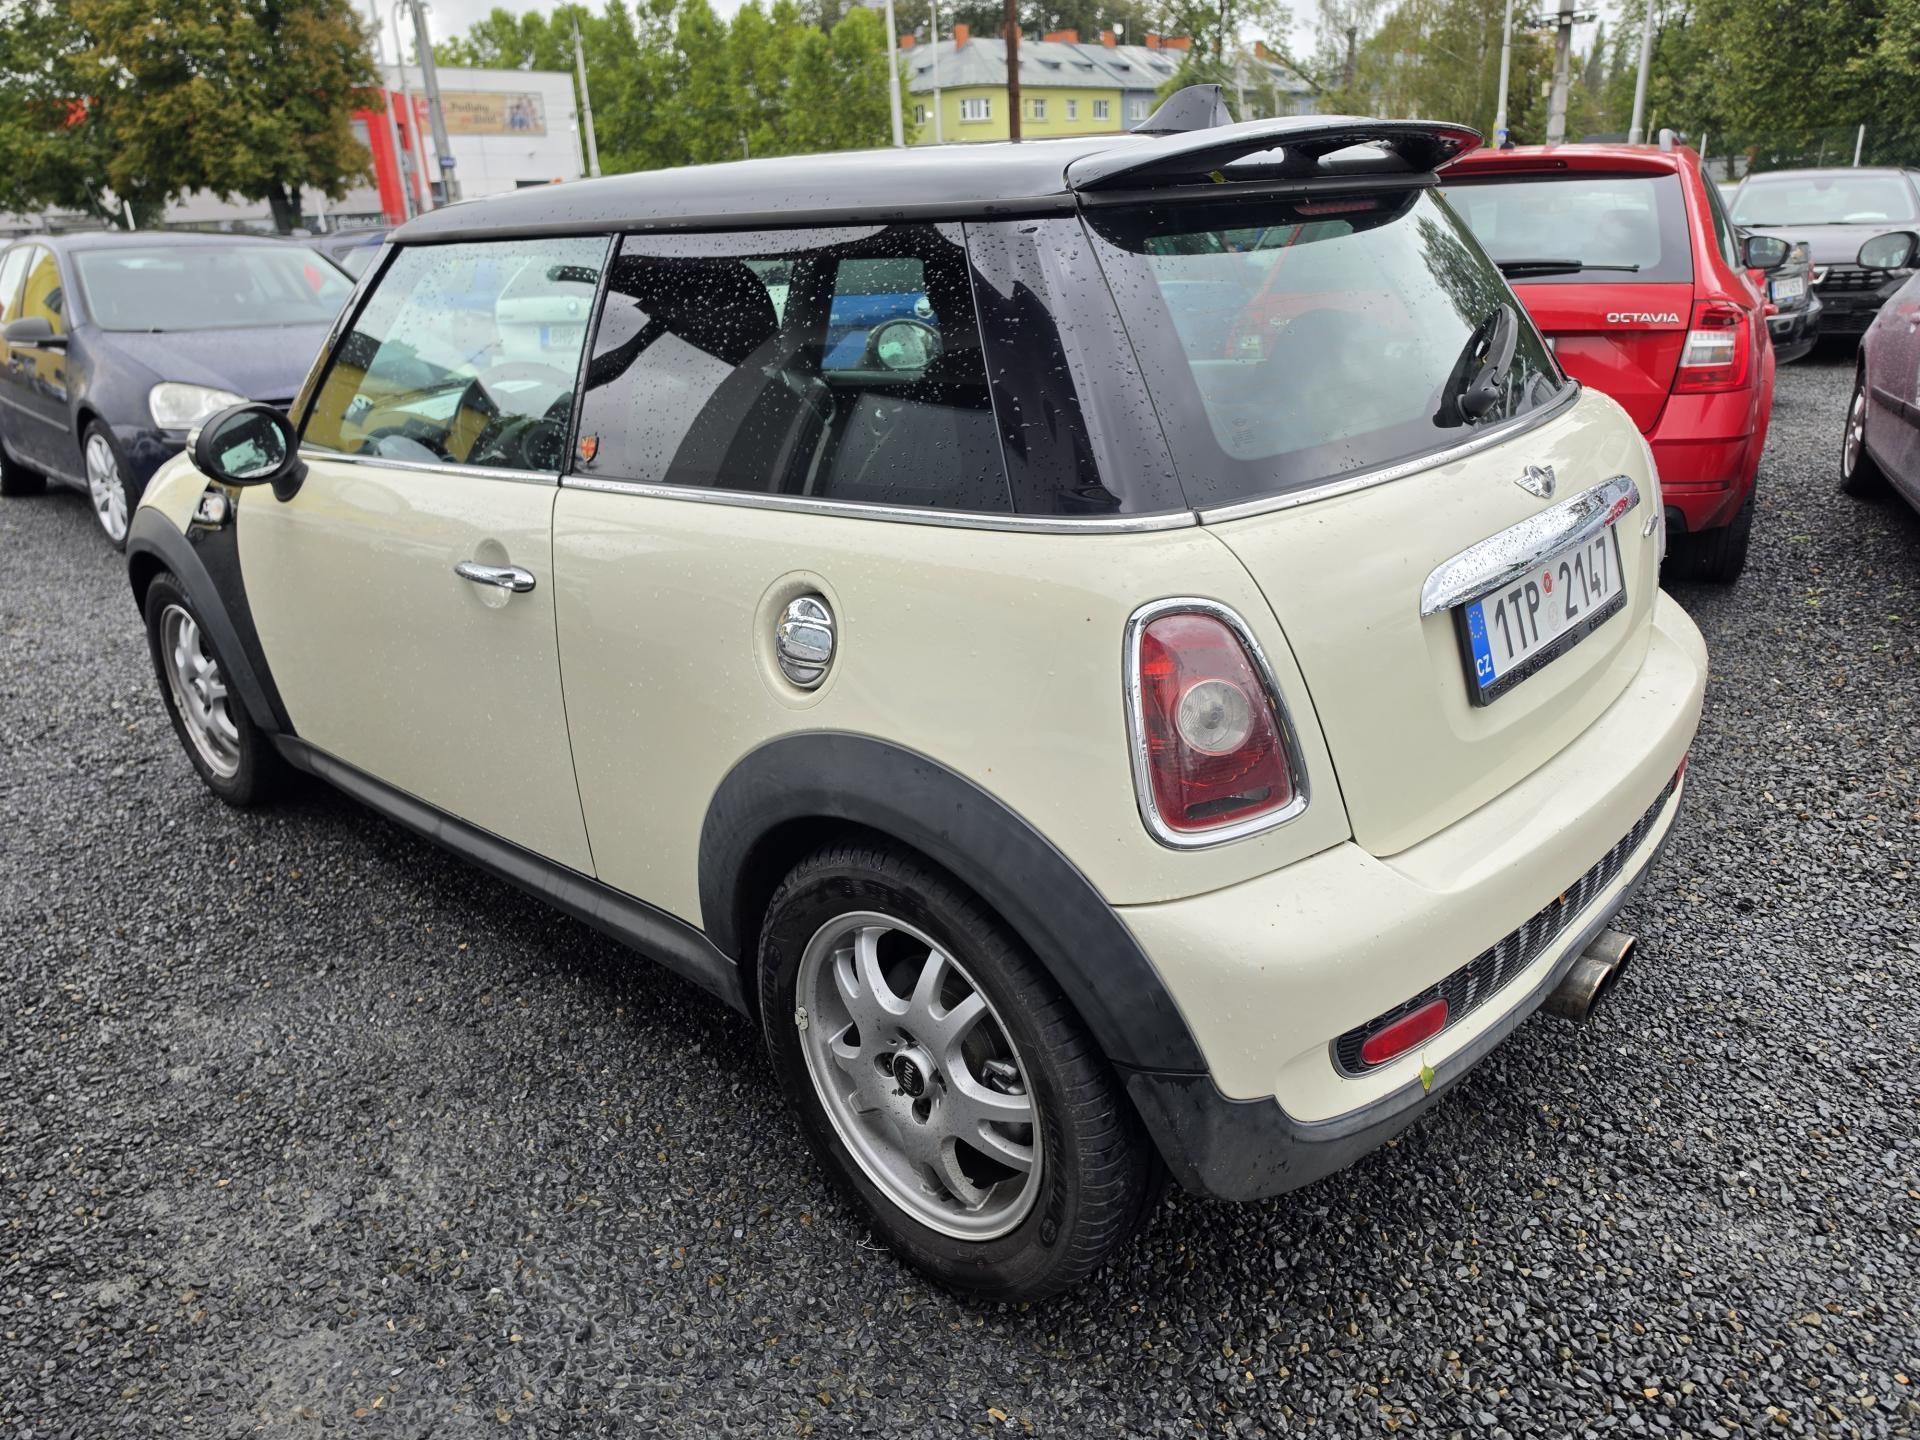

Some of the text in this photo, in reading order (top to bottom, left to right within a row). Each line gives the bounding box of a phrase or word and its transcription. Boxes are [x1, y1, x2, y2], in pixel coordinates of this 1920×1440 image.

[1606, 312, 1680, 324] OCTAVIA
[1495, 580, 1540, 659] 1TP
[1558, 535, 1608, 621] 2147
[1476, 653, 1492, 677] CZ
[903, 1061, 914, 1091] MINI
